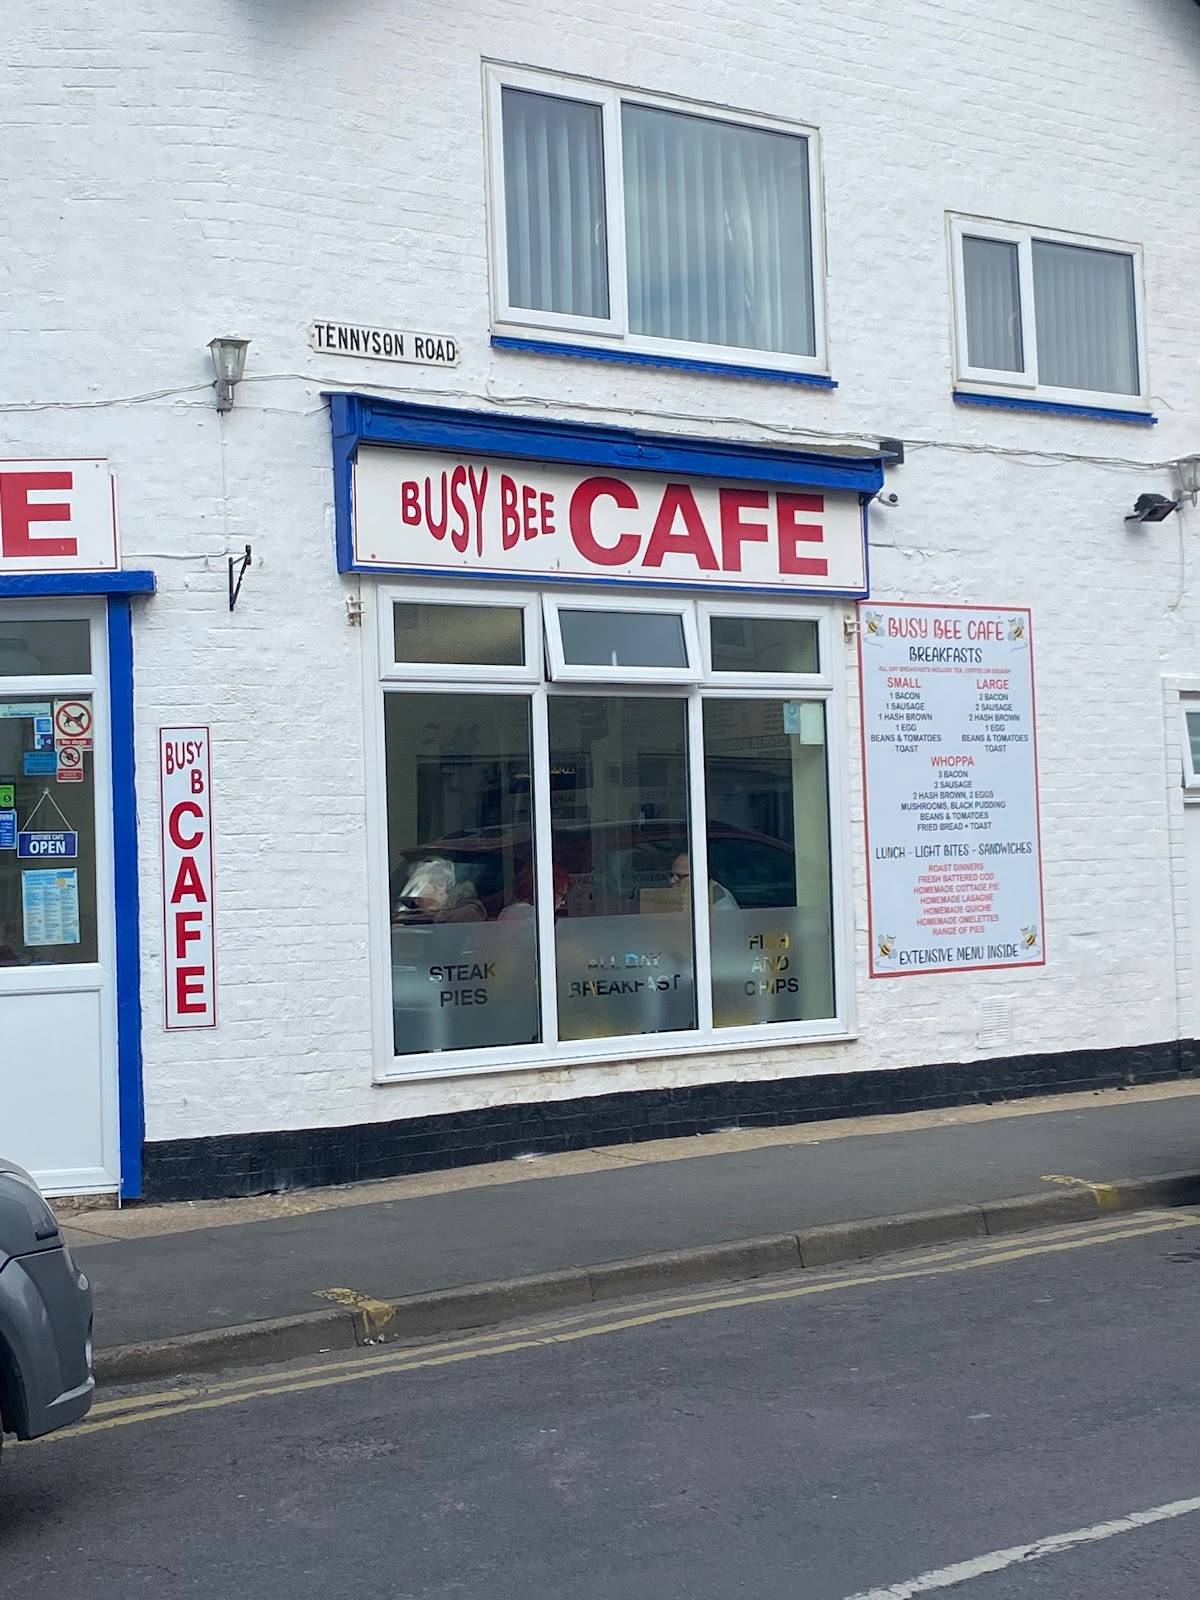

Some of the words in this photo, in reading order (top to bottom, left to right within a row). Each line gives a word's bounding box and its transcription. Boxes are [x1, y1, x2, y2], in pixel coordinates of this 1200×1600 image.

[315, 324, 404, 356] TENNYSON
[415, 337, 455, 361] ROAD
[402, 465, 489, 557] BUSY
[502, 474, 555, 551] BEE
[569, 476, 829, 576] CAFE
[888, 617, 927, 638] BUSY
[934, 620, 962, 639] BEE
[968, 621, 1004, 641] CAFE
[909, 646, 982, 663] BREAKFASTS
[887, 677, 921, 688] SMALL
[977, 680, 1009, 689] LARGE
[895, 692, 920, 700] BACON
[166, 741, 203, 775] BUSY
[931, 756, 974, 767] WHOPPA
[191, 769, 204, 794] B
[952, 812, 988, 820] TOMATOES
[970, 822, 992, 830] TOAST
[29, 841, 66, 854] OPEN
[876, 847, 905, 859] LUNCH
[915, 845, 941, 858] LIGHT
[944, 844, 969, 857] BITES
[979, 842, 1032, 855] SANDWICHES
[929, 864, 952, 872] ROAST
[953, 863, 983, 871] DINNERS
[918, 875, 941, 883] FRESH
[943, 874, 978, 882] BATTERED
[914, 885, 954, 894] HOMEMADE
[956, 884, 987, 892] COTTAGE
[169, 801, 207, 1014] CAFE
[920, 896, 960, 904] HOMEMADE
[962, 894, 993, 902] LASAGNE
[924, 906, 964, 914] HOMEMADE
[965, 905, 991, 913] QUICHE
[917, 917, 957, 925] HOMEMADE
[959, 915, 999, 924] OMELETTES
[932, 928, 957, 936] RANGE
[750, 933, 789, 950] FIH
[900, 948, 953, 965] EXTENSIVE
[957, 946, 984, 960] MENU
[987, 944, 1019, 958] INSIDE
[430, 963, 496, 982] STEAK
[752, 956, 788, 973] AND
[569, 974, 680, 998] BREAKFAST
[744, 978, 798, 996] CHIPS
[440, 988, 488, 1007] PIES
